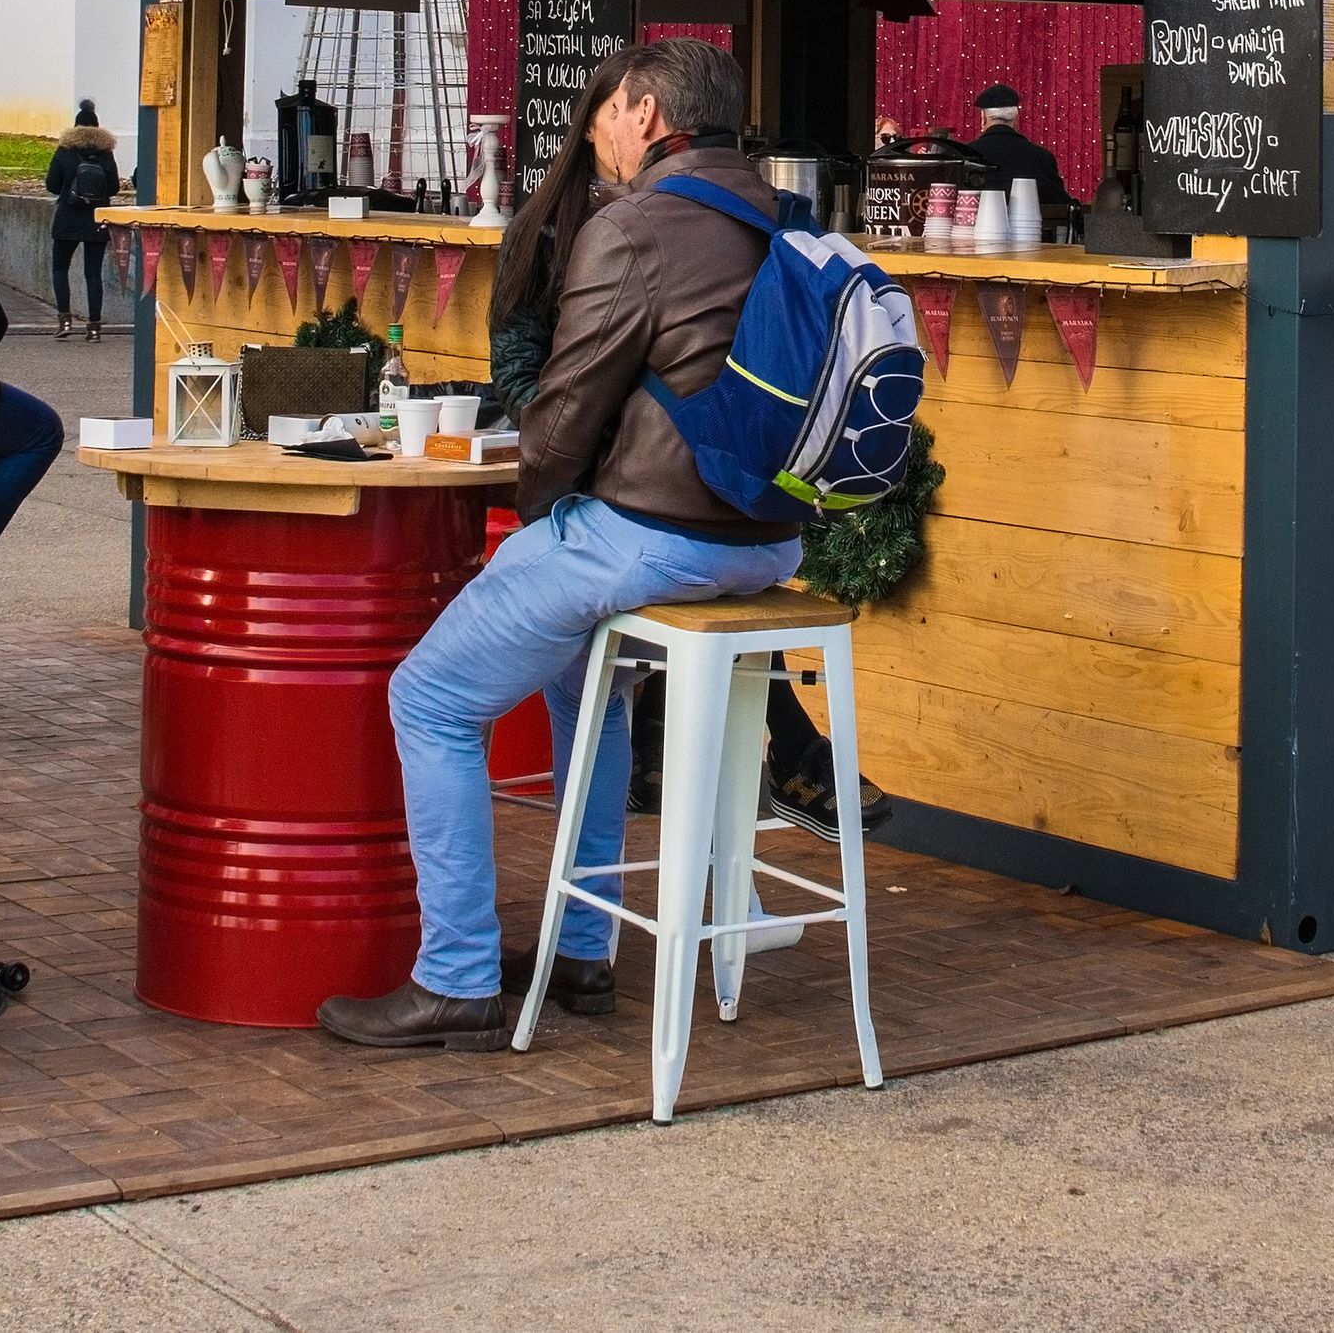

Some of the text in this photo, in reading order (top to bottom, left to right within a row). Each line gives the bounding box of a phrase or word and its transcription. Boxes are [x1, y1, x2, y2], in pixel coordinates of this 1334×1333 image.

[526, 0, 542, 20] SA
[1151, 20, 1207, 65] RUM
[525, 63, 598, 90] SA KUKUR
[1146, 112, 1262, 170] WHISKEY
[870, 172, 915, 181] MARASKA
[1177, 168, 1233, 212] CHILLY
[866, 187, 901, 203] AILOR'S
